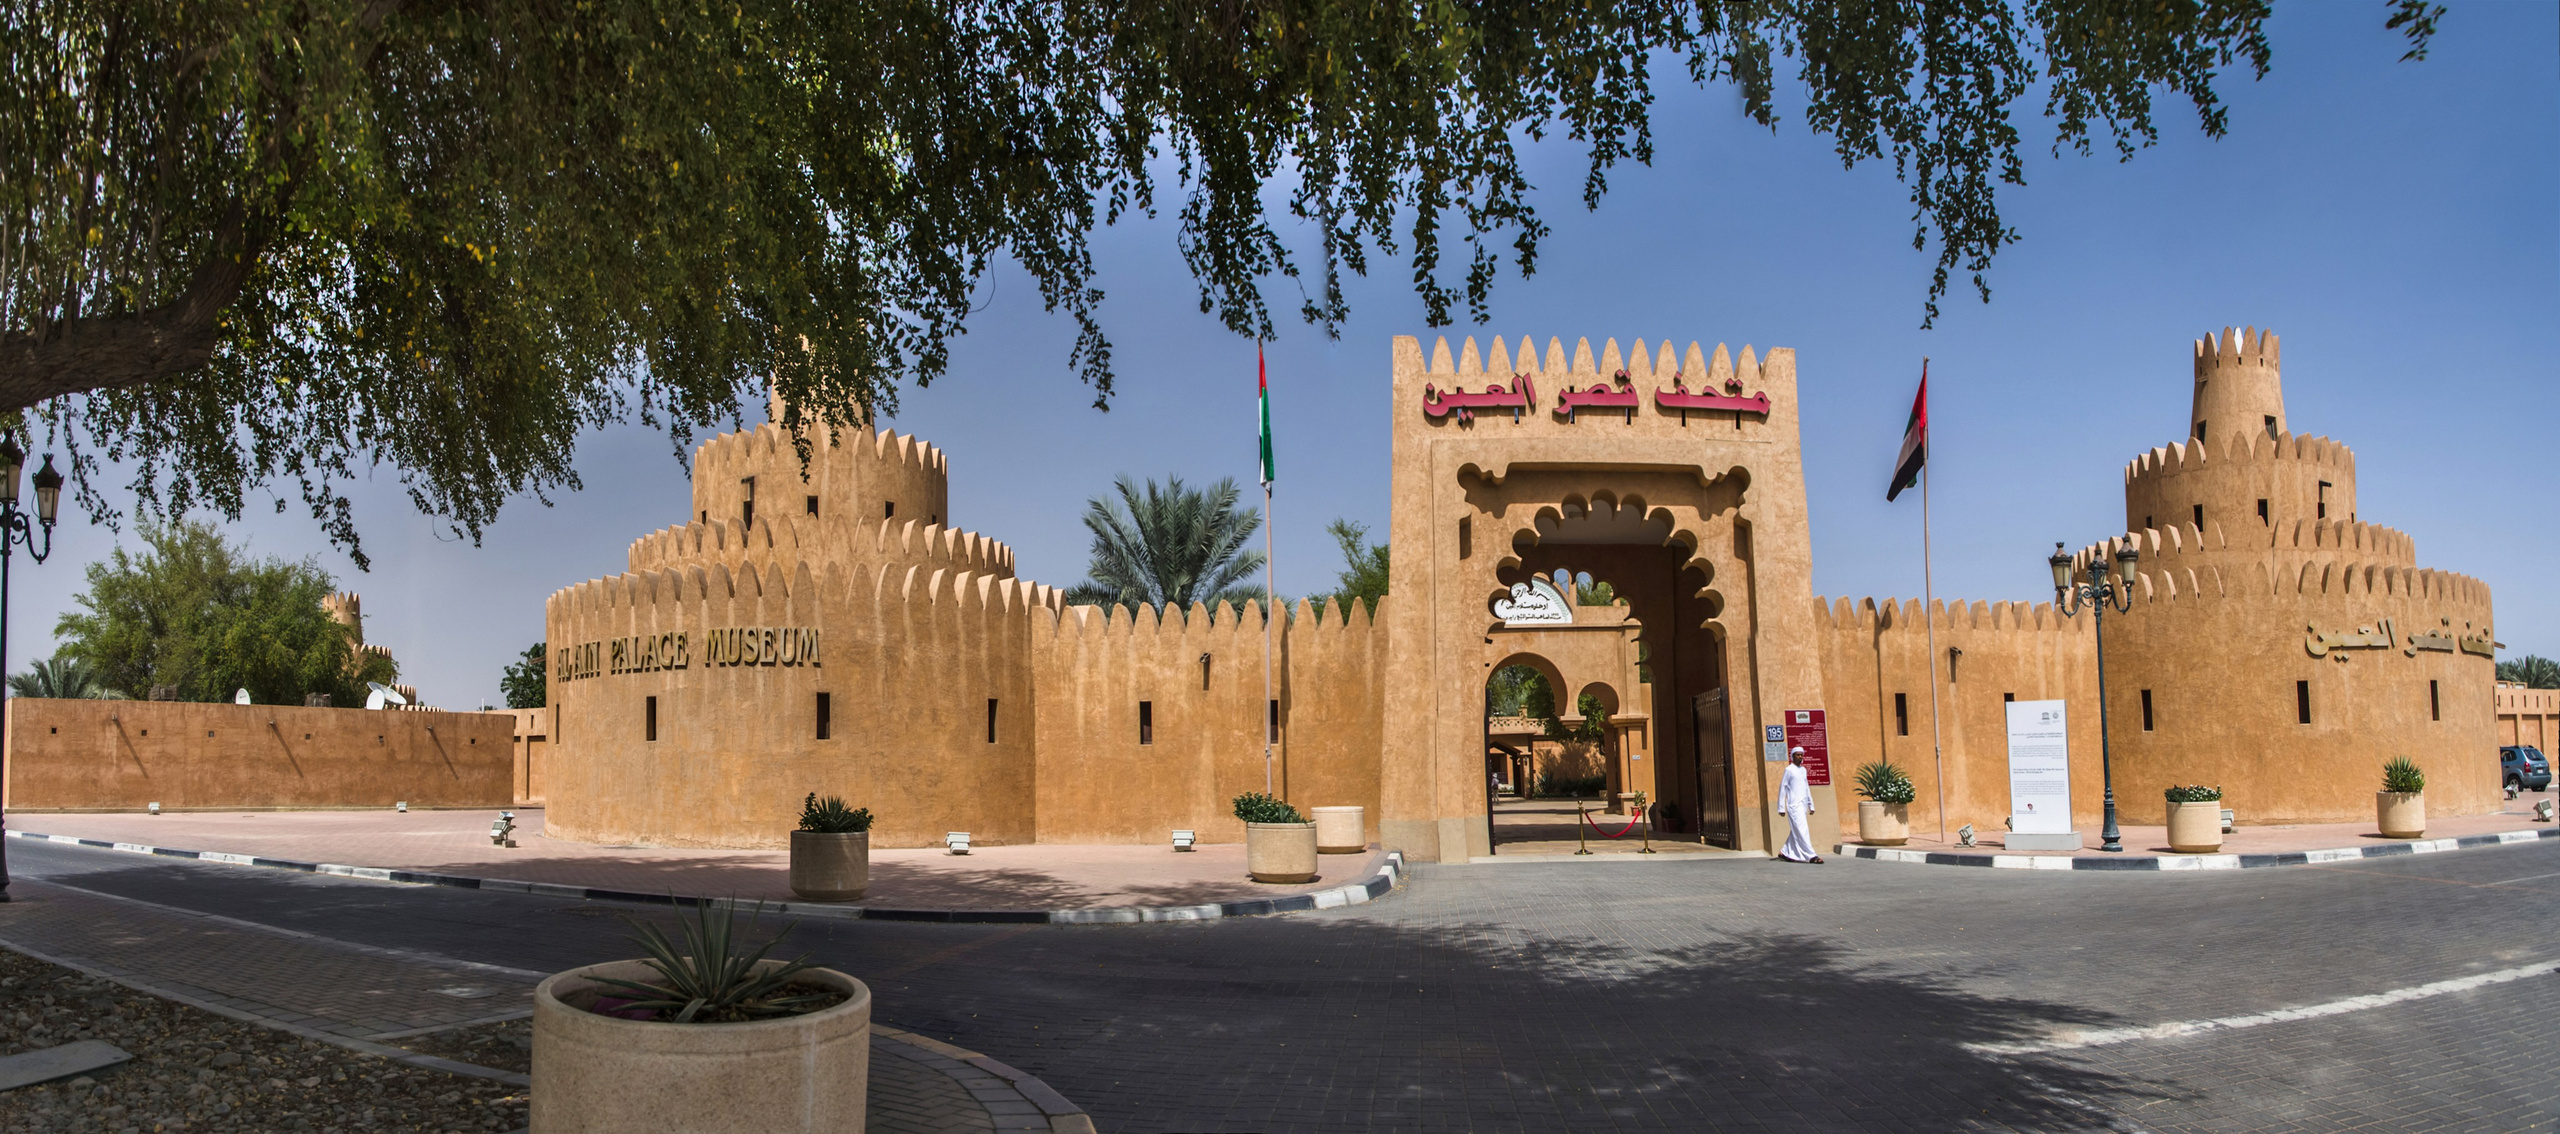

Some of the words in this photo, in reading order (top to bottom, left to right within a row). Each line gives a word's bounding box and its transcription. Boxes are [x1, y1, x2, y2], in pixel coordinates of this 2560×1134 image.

[1423, 372, 1537, 423] العين
[1553, 369, 1640, 414] قصر
[1654, 371, 1772, 415] متحف
[610, 631, 689, 674] PALACE
[705, 627, 821, 667] MUSEUM
[2306, 616, 2397, 663] العين
[2404, 616, 2455, 658] قصر
[1768, 727, 1782, 738] 195
